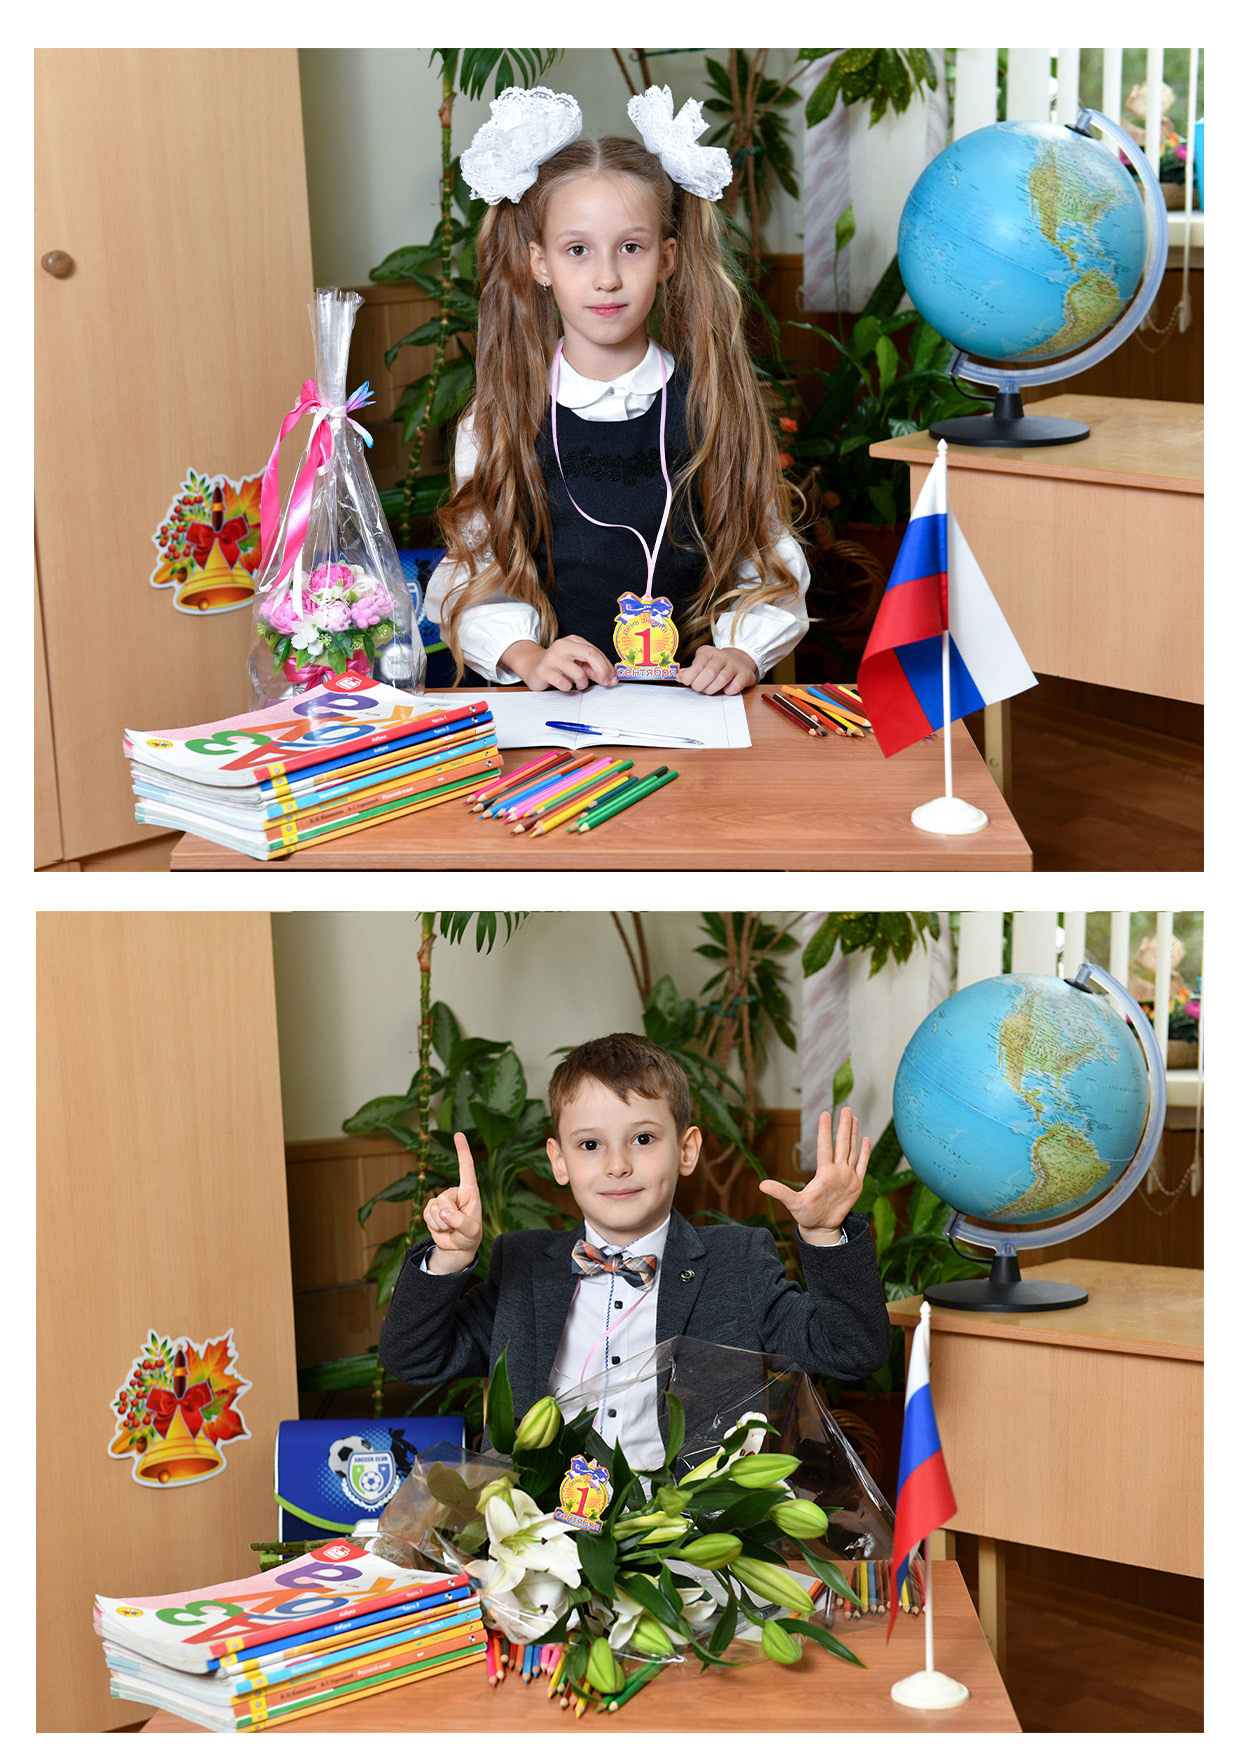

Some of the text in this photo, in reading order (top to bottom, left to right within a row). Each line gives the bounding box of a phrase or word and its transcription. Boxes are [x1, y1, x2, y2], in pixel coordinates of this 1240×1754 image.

[635, 627, 658, 666] 1
[617, 667, 676, 678] сентября
[571, 1487, 589, 1518] 1
[555, 1511, 600, 1531] сентября
